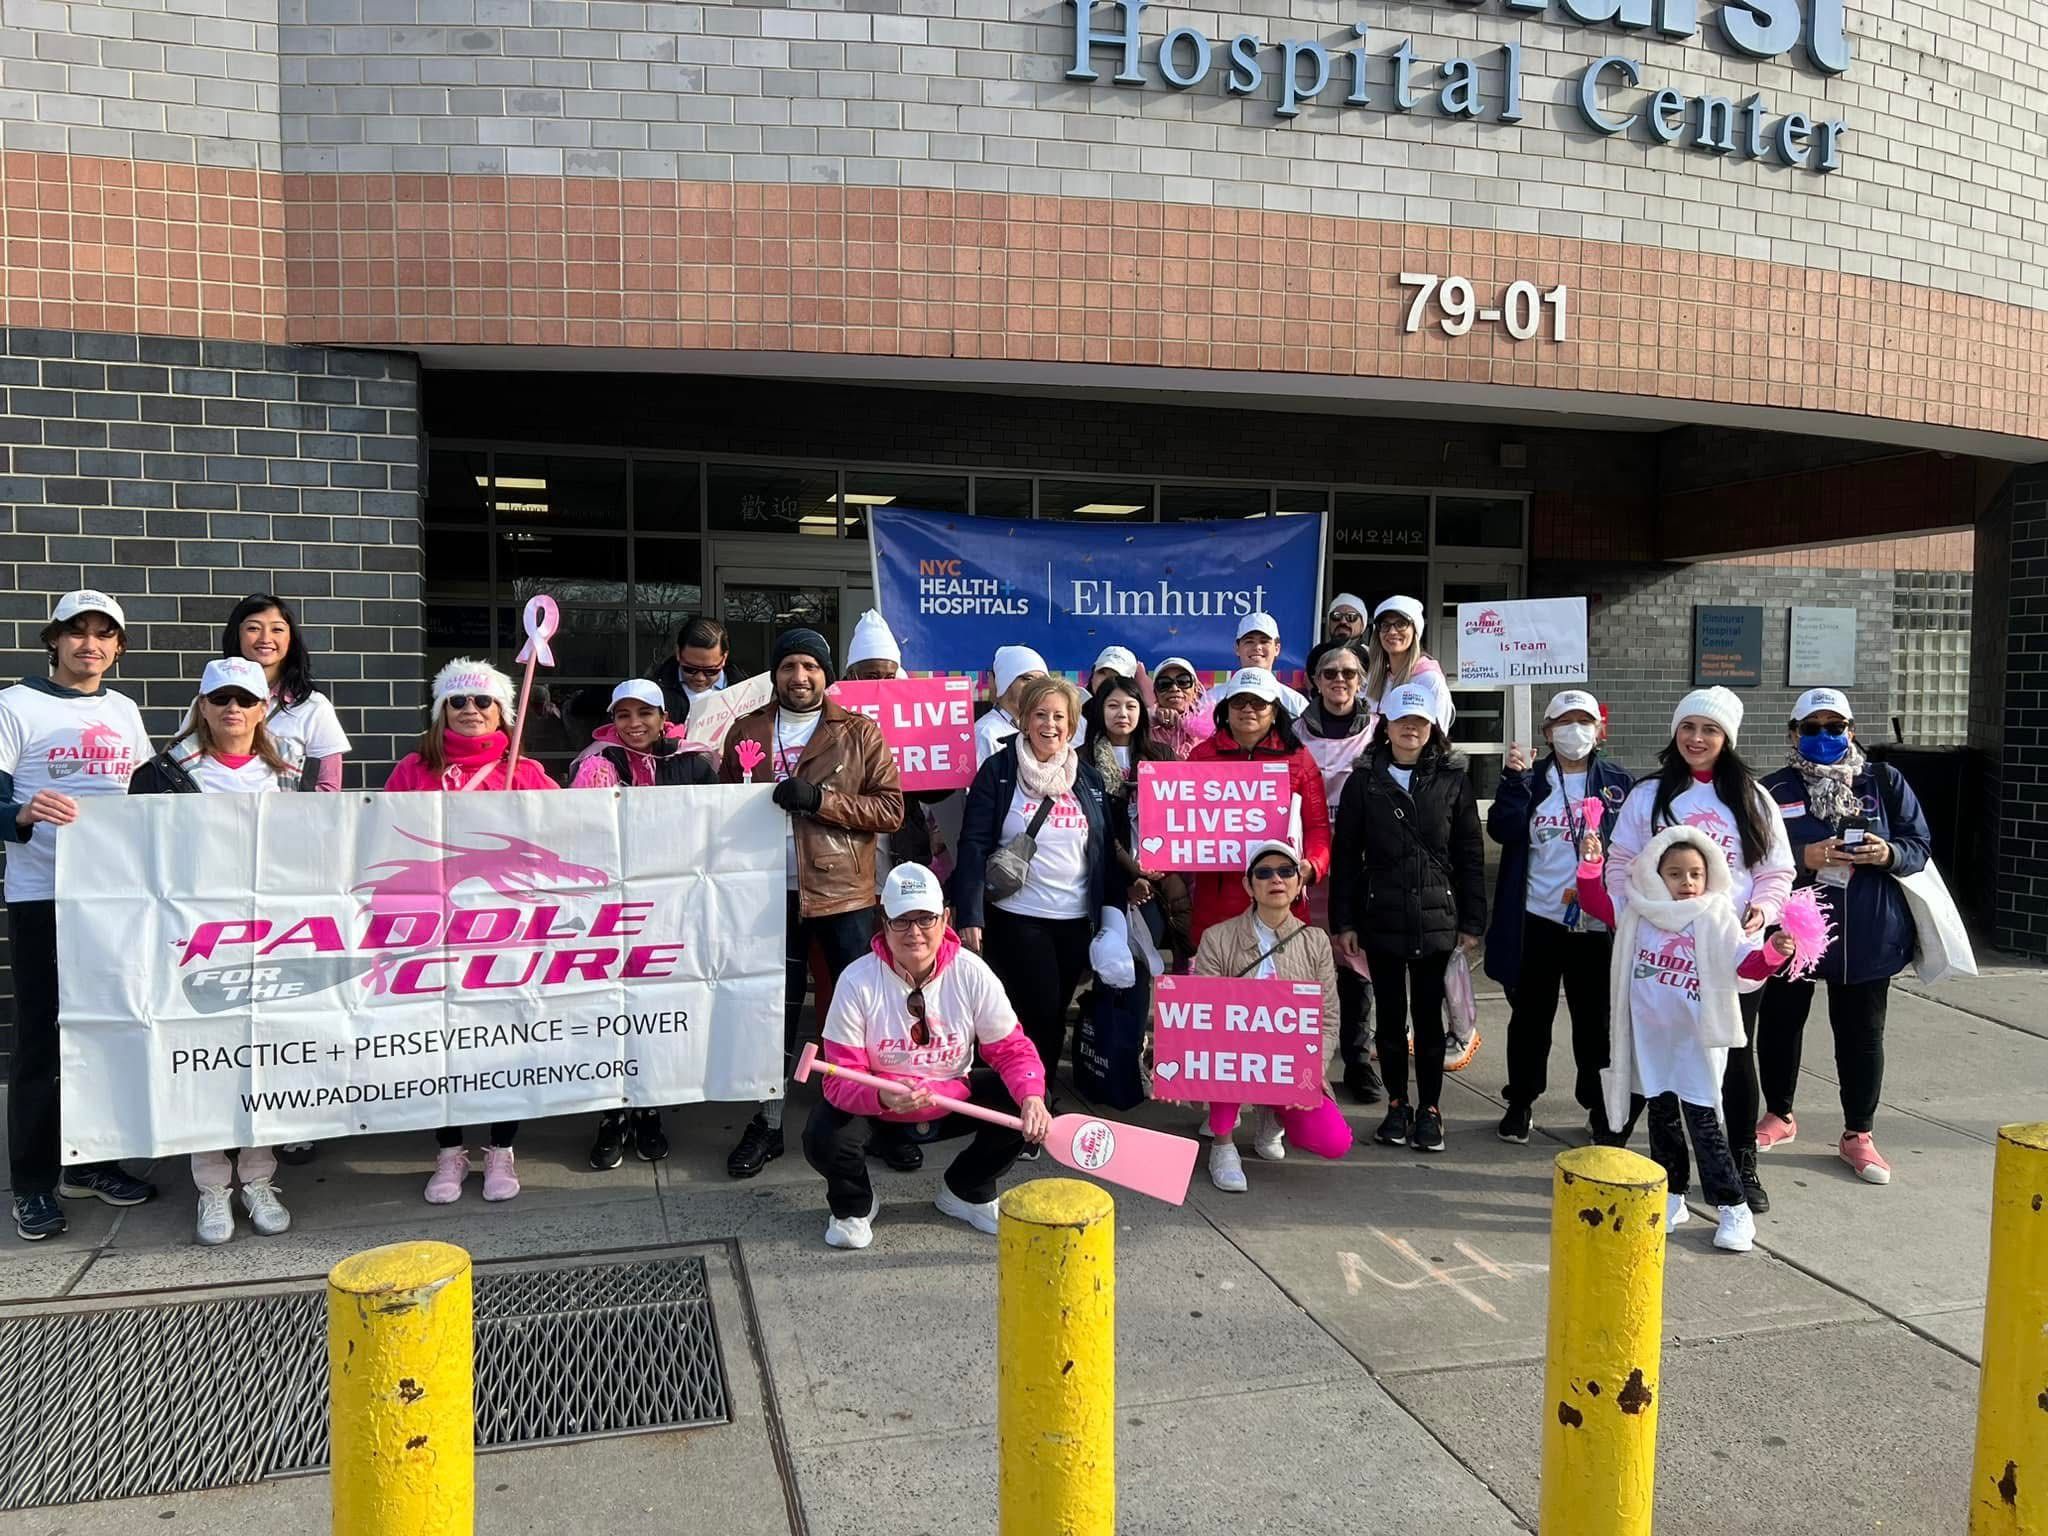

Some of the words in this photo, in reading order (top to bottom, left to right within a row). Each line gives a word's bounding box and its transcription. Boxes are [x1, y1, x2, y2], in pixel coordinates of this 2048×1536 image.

[1065, 0, 1524, 124] Hospital
[1576, 54, 1849, 172] Center
[1399, 271, 1567, 342] 79-01
[919, 559, 962, 577] NYC
[919, 598, 1029, 615] HOSPITALS
[1070, 580, 1267, 617] Elmhurst
[1702, 625, 1742, 638] Hospital
[1702, 637, 1735, 648] Center
[1500, 642, 1510, 652] Is
[1513, 640, 1547, 651] Team
[1509, 660, 1586, 677] Elmhurst
[717, 710, 729, 721] TO
[893, 700, 970, 729] LIVE
[48, 746, 131, 761] PADDLE
[889, 744, 951, 773] ERE
[1151, 780, 1196, 801] WE
[1203, 780, 1277, 801] SAVE
[1166, 807, 1267, 833] LIVES
[178, 901, 655, 968] PADDLE
[191, 967, 283, 986] FOR
[389, 943, 685, 995] CURE
[221, 982, 304, 1001] THE
[1658, 972, 1700, 991] CUR
[1157, 1001, 1213, 1030] WE
[1225, 1004, 1320, 1035] RACE
[172, 1040, 318, 1074] PRACTICE
[326, 1044, 345, 1061] +
[354, 1019, 564, 1060] PERSEVERANCE
[596, 1011, 689, 1038] POWER
[1184, 1051, 1295, 1084] HERE
[240, 1059, 639, 1113] WWW.PADDLEFORTHECURENYC.ORG
